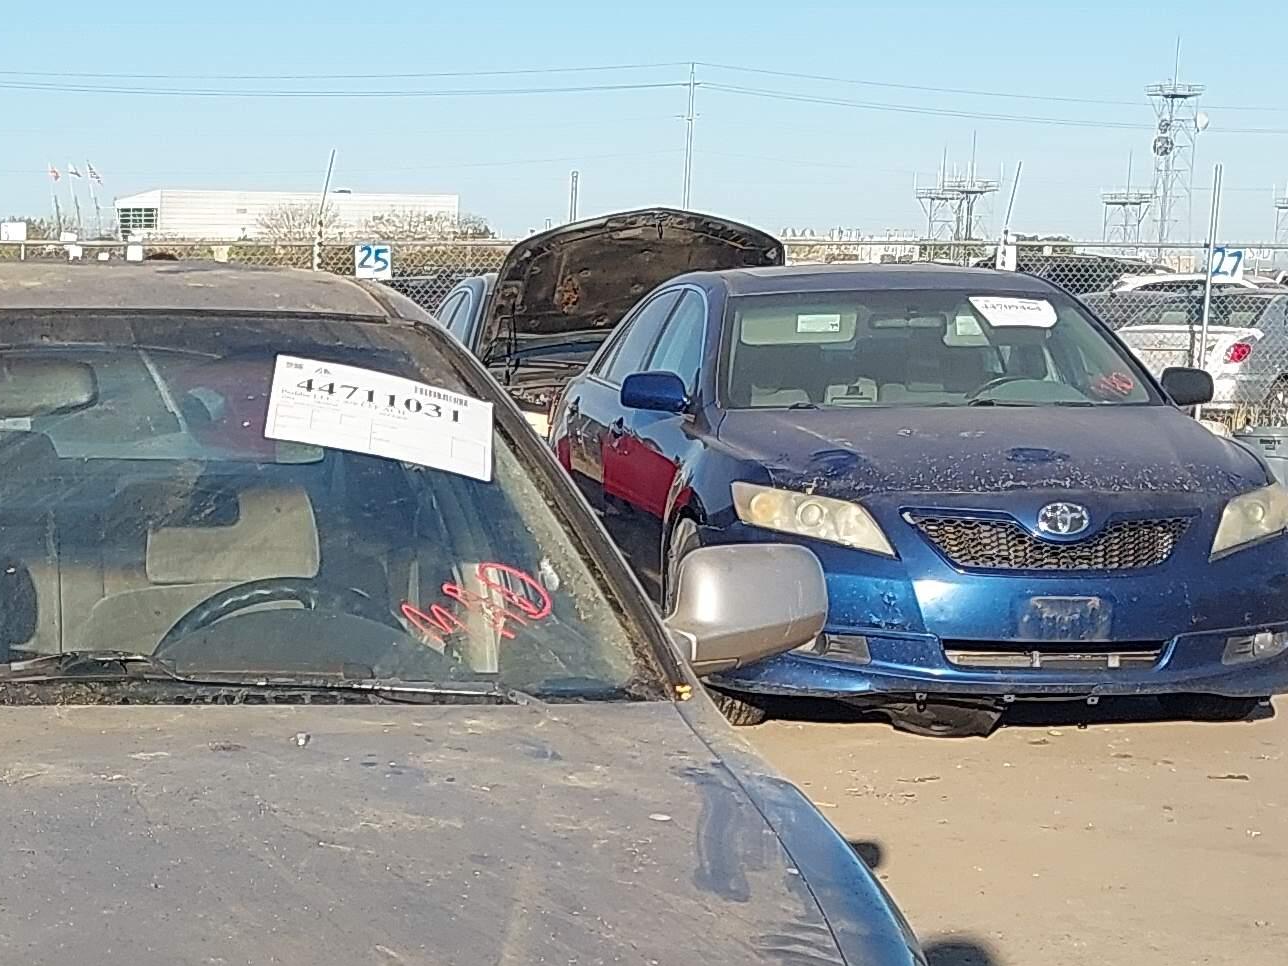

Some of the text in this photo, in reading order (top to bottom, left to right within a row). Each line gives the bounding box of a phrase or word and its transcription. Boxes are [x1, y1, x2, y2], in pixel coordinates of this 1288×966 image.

[358, 244, 389, 272] 25
[1211, 246, 1243, 277] 27
[296, 378, 462, 424] 44711031
